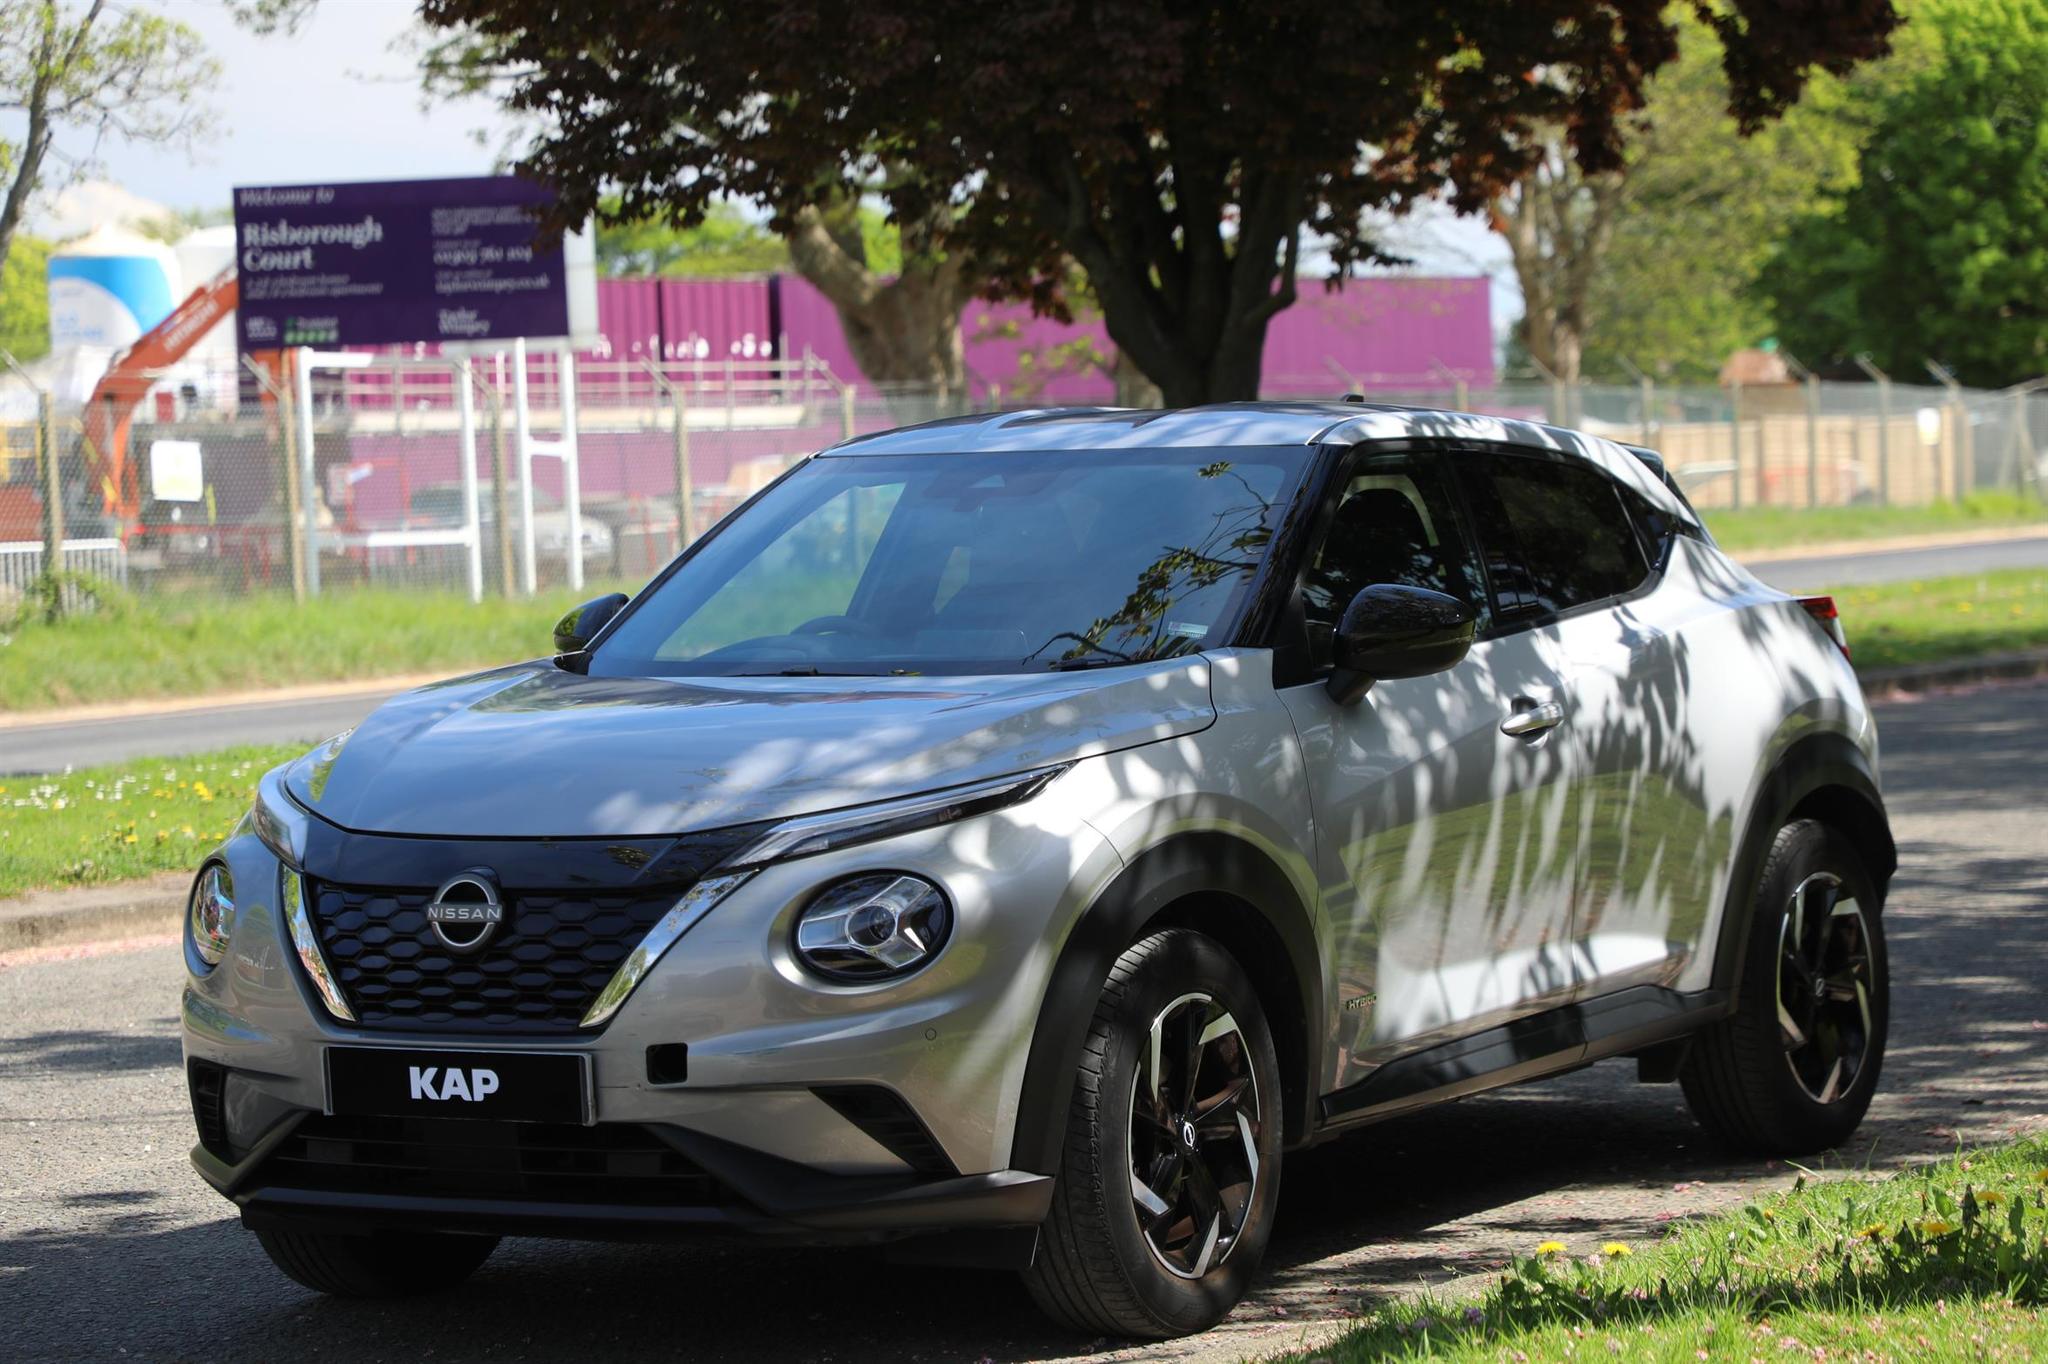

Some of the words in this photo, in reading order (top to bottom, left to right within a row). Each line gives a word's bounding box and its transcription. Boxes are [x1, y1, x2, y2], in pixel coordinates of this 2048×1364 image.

[315, 187, 335, 204] to
[243, 214, 383, 250] Risborough
[243, 246, 313, 272] Court
[427, 907, 501, 920] NISSAN
[409, 1066, 500, 1102] KAP
